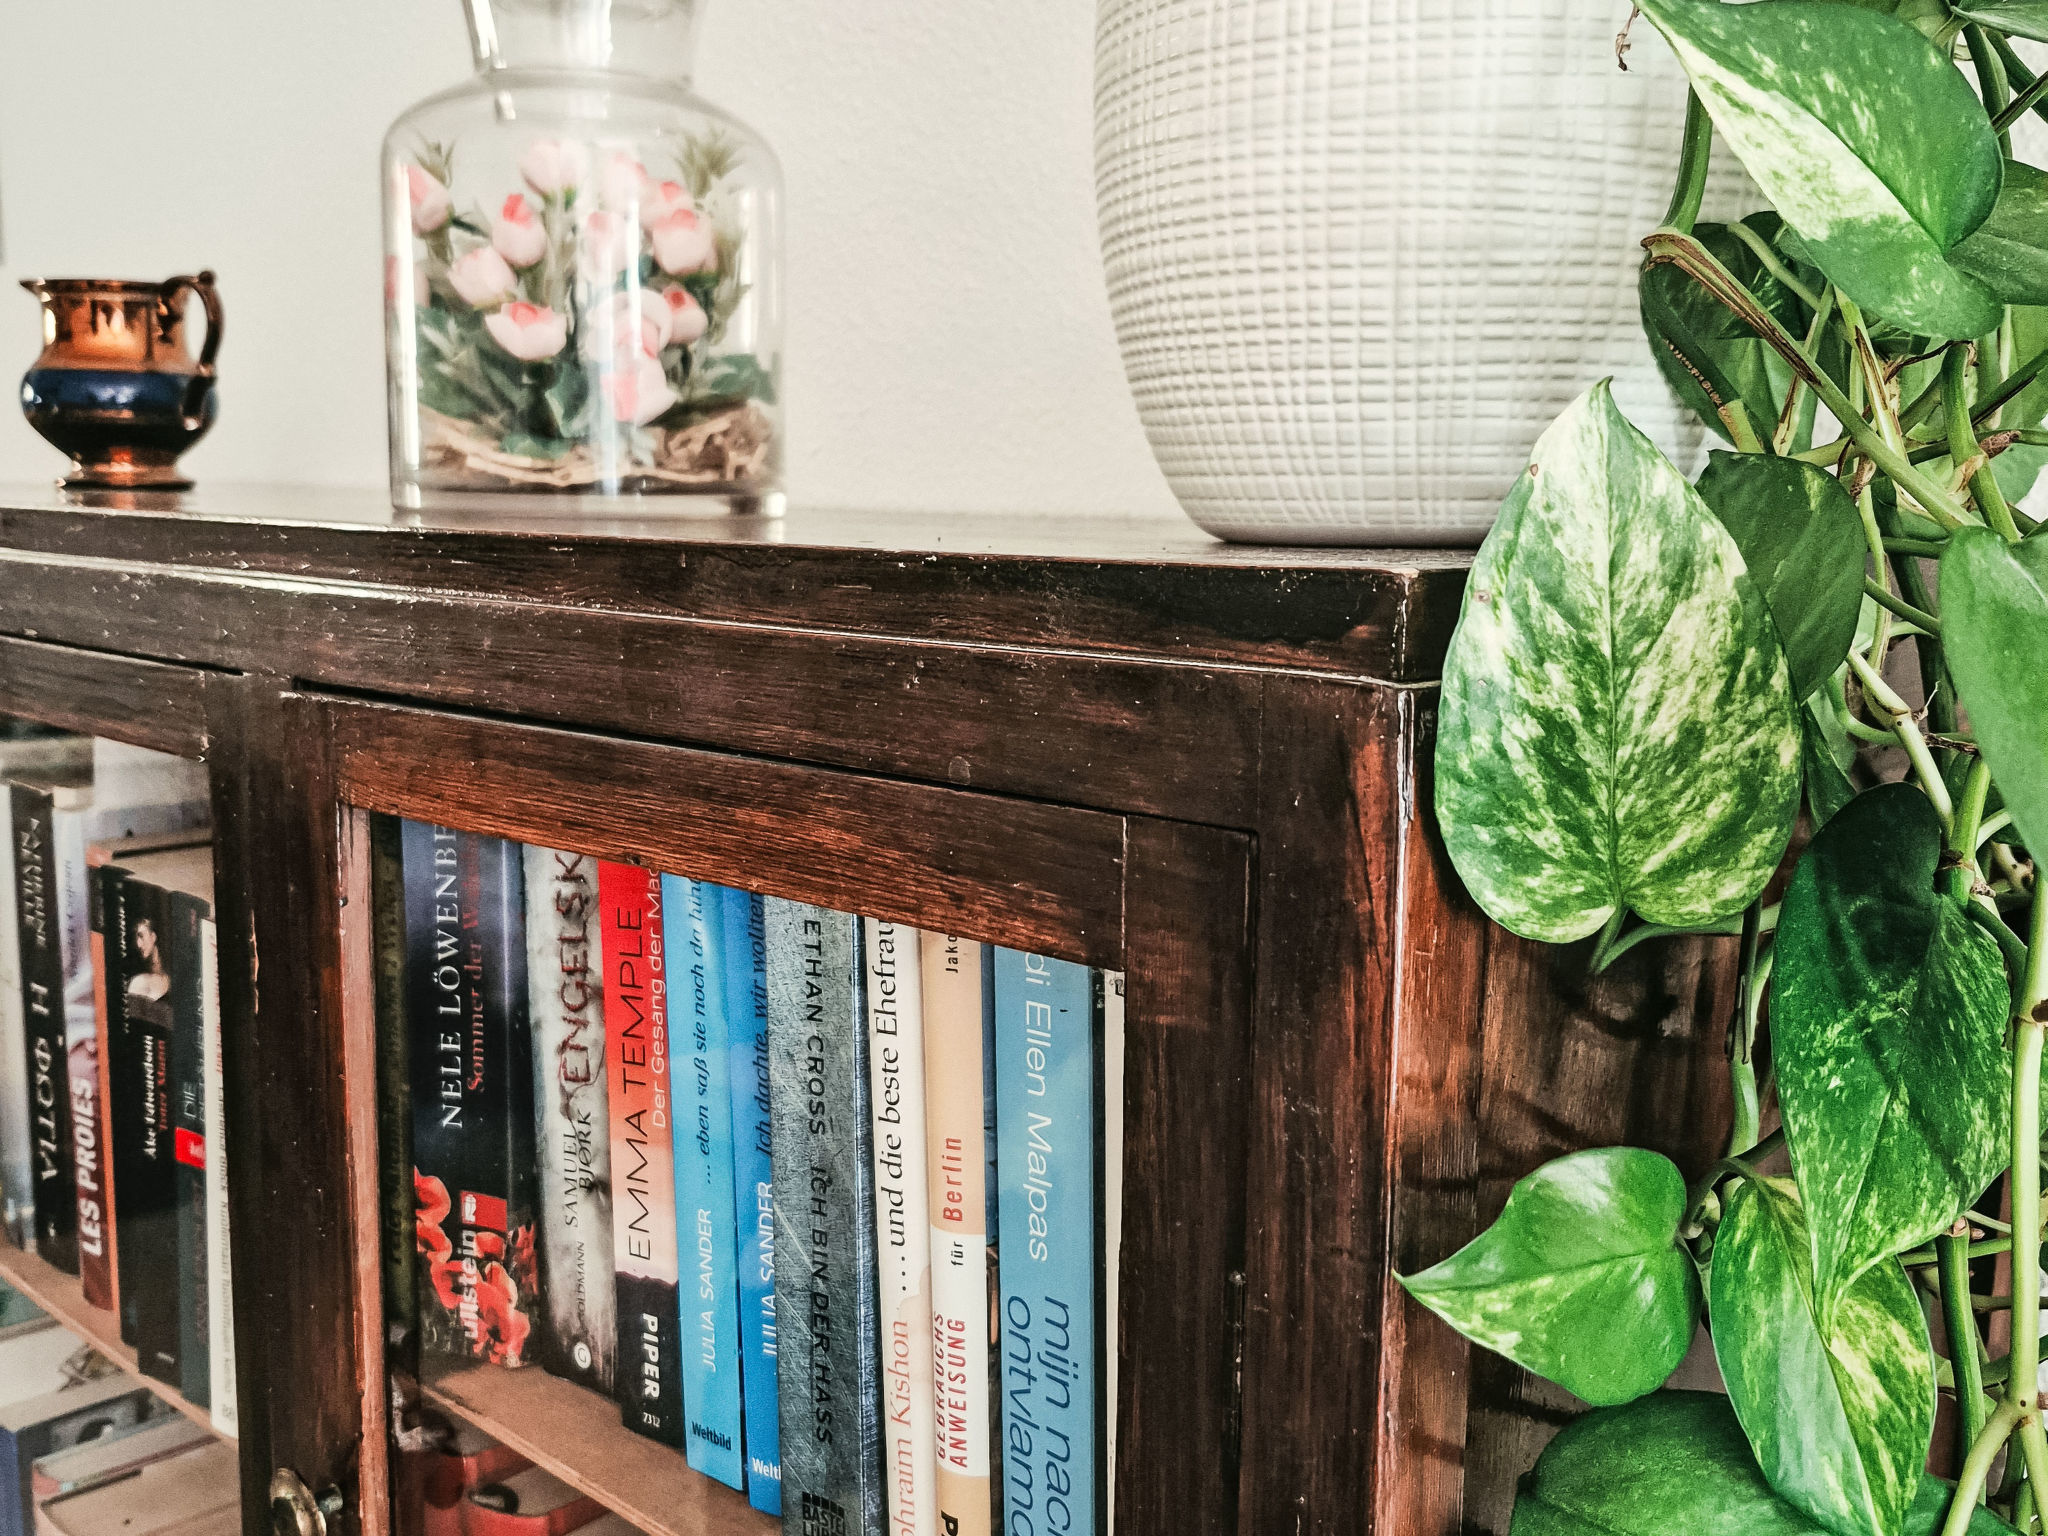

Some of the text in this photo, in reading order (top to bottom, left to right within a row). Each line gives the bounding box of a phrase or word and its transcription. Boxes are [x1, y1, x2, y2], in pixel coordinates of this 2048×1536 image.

[648, 932, 662, 971] der
[689, 932, 703, 957] da
[690, 965, 705, 1018] noch
[467, 986, 484, 1093] Sommer
[650, 975, 667, 1075] Gesang
[691, 1022, 707, 1052] sie
[748, 979, 769, 1019] wir
[803, 919, 826, 1136] ETHAN CROSS
[440, 1032, 463, 1129] NELE
[617, 906, 650, 1261] EMMA TEMPLE
[693, 1056, 710, 1096] saß
[876, 1047, 900, 1125] beste
[1025, 1000, 1051, 1097] Ellen
[577, 1108, 593, 1191] BJØRK
[652, 1082, 666, 1128] Der
[696, 1104, 710, 1156] eben
[71, 1077, 102, 1257] LES PROIES
[563, 1133, 579, 1228] SAMUEL
[880, 1133, 904, 1180] die
[1022, 1111, 1054, 1263] Malpas
[457, 1229, 479, 1339] ullstein
[697, 1208, 717, 1372] JULIA SANDER
[810, 1165, 833, 1447] ICH BIN DER HASS
[942, 1136, 968, 1468] ANWEISUNG für Berlin
[642, 1312, 660, 1400] PIPER
[887, 1320, 911, 1429] Kishon
[933, 1311, 947, 1461] GEBRAUCHS
[1037, 1295, 1079, 1409] mijn
[642, 1411, 661, 1428] 7312
[691, 1420, 732, 1451] Weltbild
